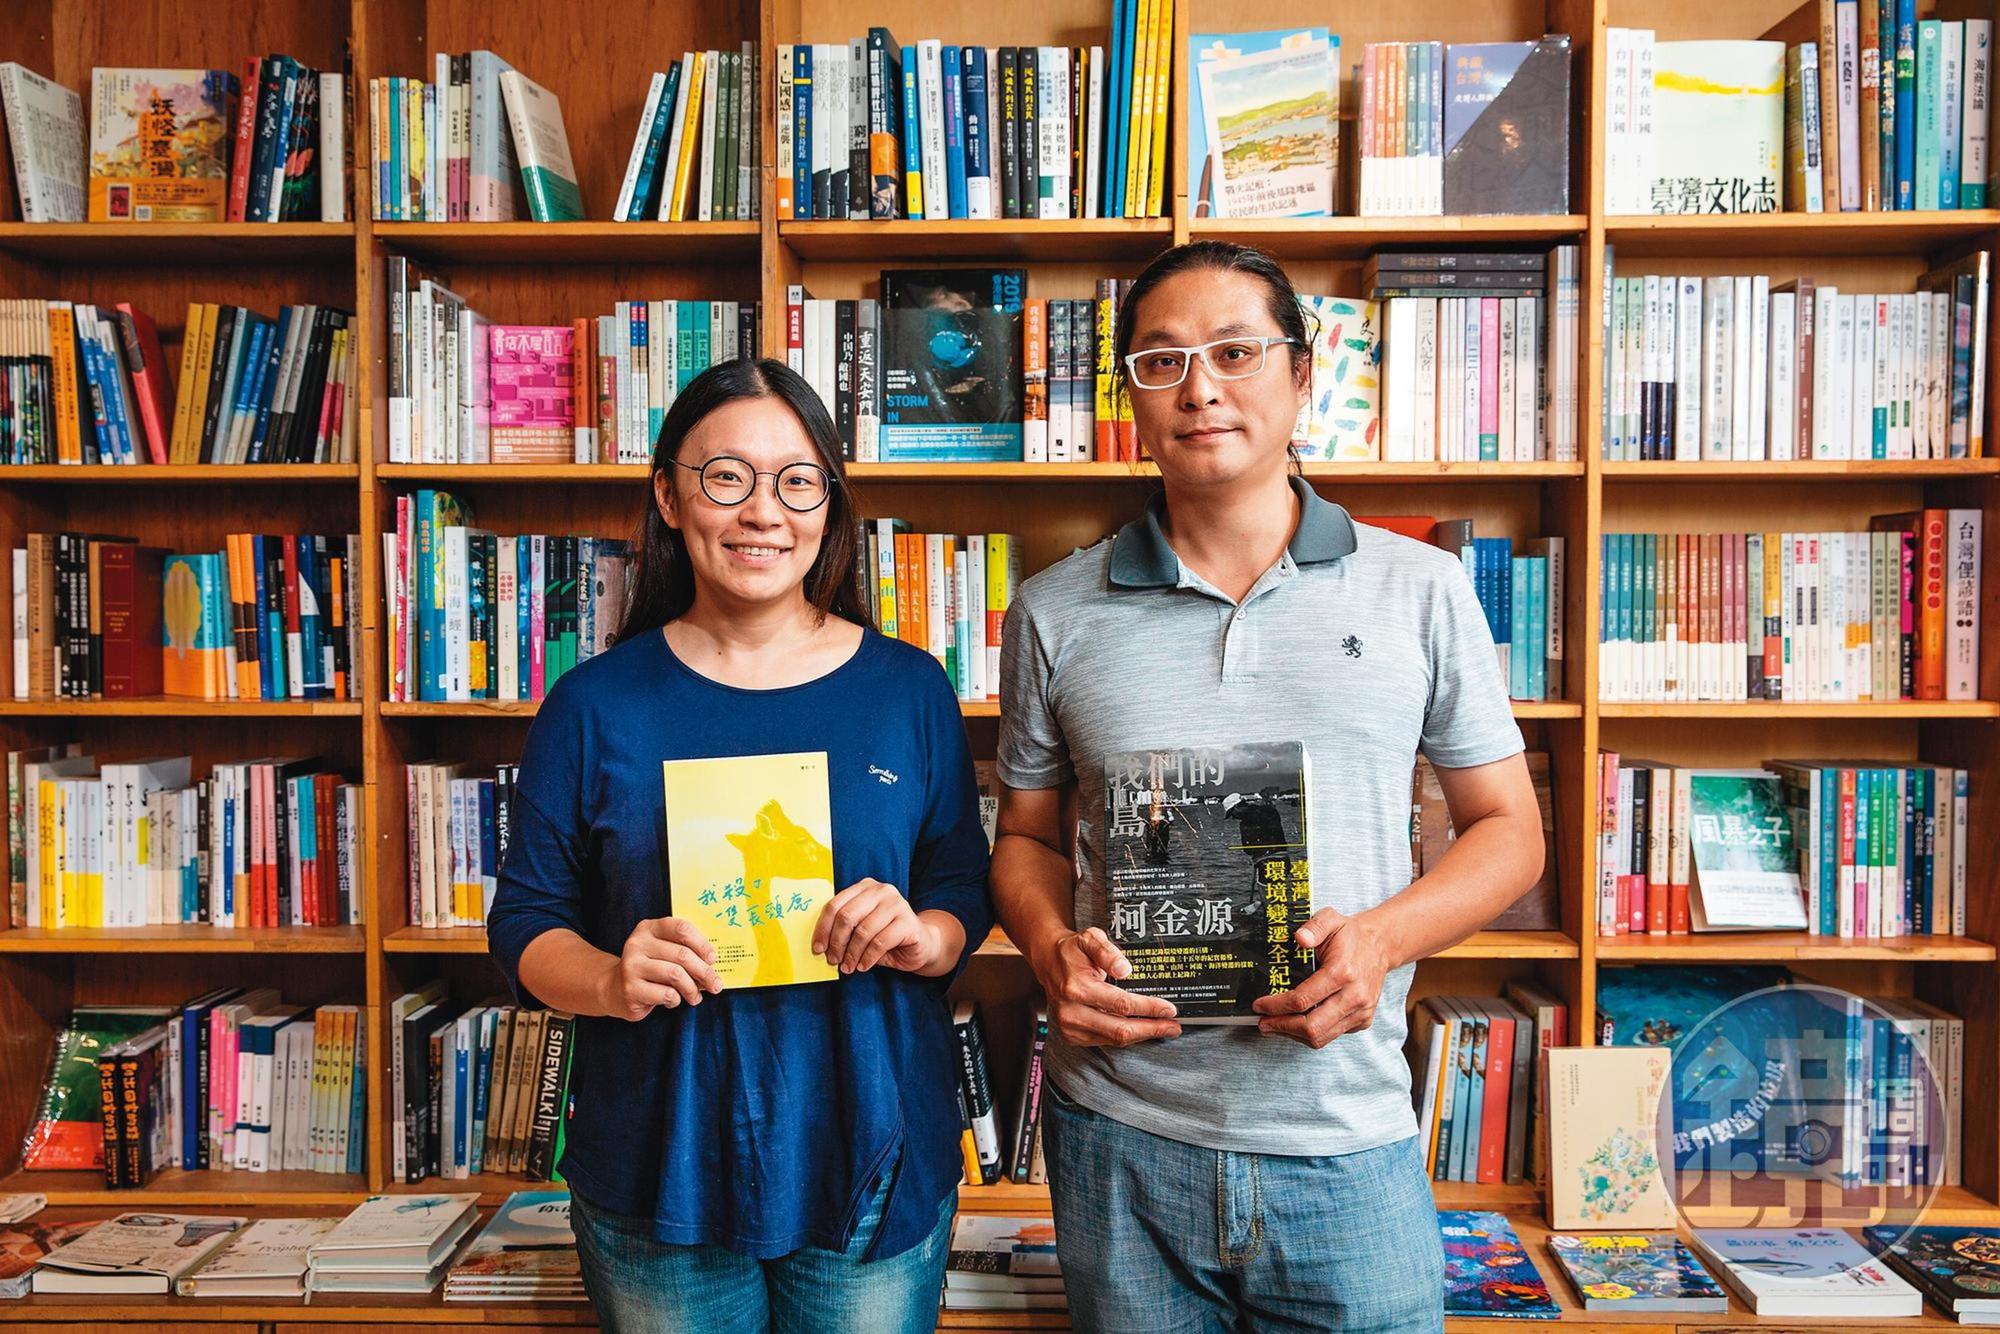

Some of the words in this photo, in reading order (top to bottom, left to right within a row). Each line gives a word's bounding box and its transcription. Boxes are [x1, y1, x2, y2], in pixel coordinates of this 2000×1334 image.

[151, 99, 178, 178] 妖怪臺灣
[1651, 177, 1776, 215] 臺灣文化志
[1004, 275, 1020, 313] 2019
[857, 330, 875, 416] 重返天安門
[887, 395, 929, 408] STORM
[887, 412, 899, 423] IN
[1109, 752, 1225, 790] 我們的
[1109, 789, 1147, 838] 島
[1692, 814, 1791, 848] 風暴之子
[698, 877, 763, 906] 我殺了
[715, 891, 813, 928] 一隻長頸鹿
[1111, 897, 1235, 941] 柯金源
[1290, 860, 1312, 964] 臺灣三年
[538, 1029, 564, 1118] SIDEWALK
